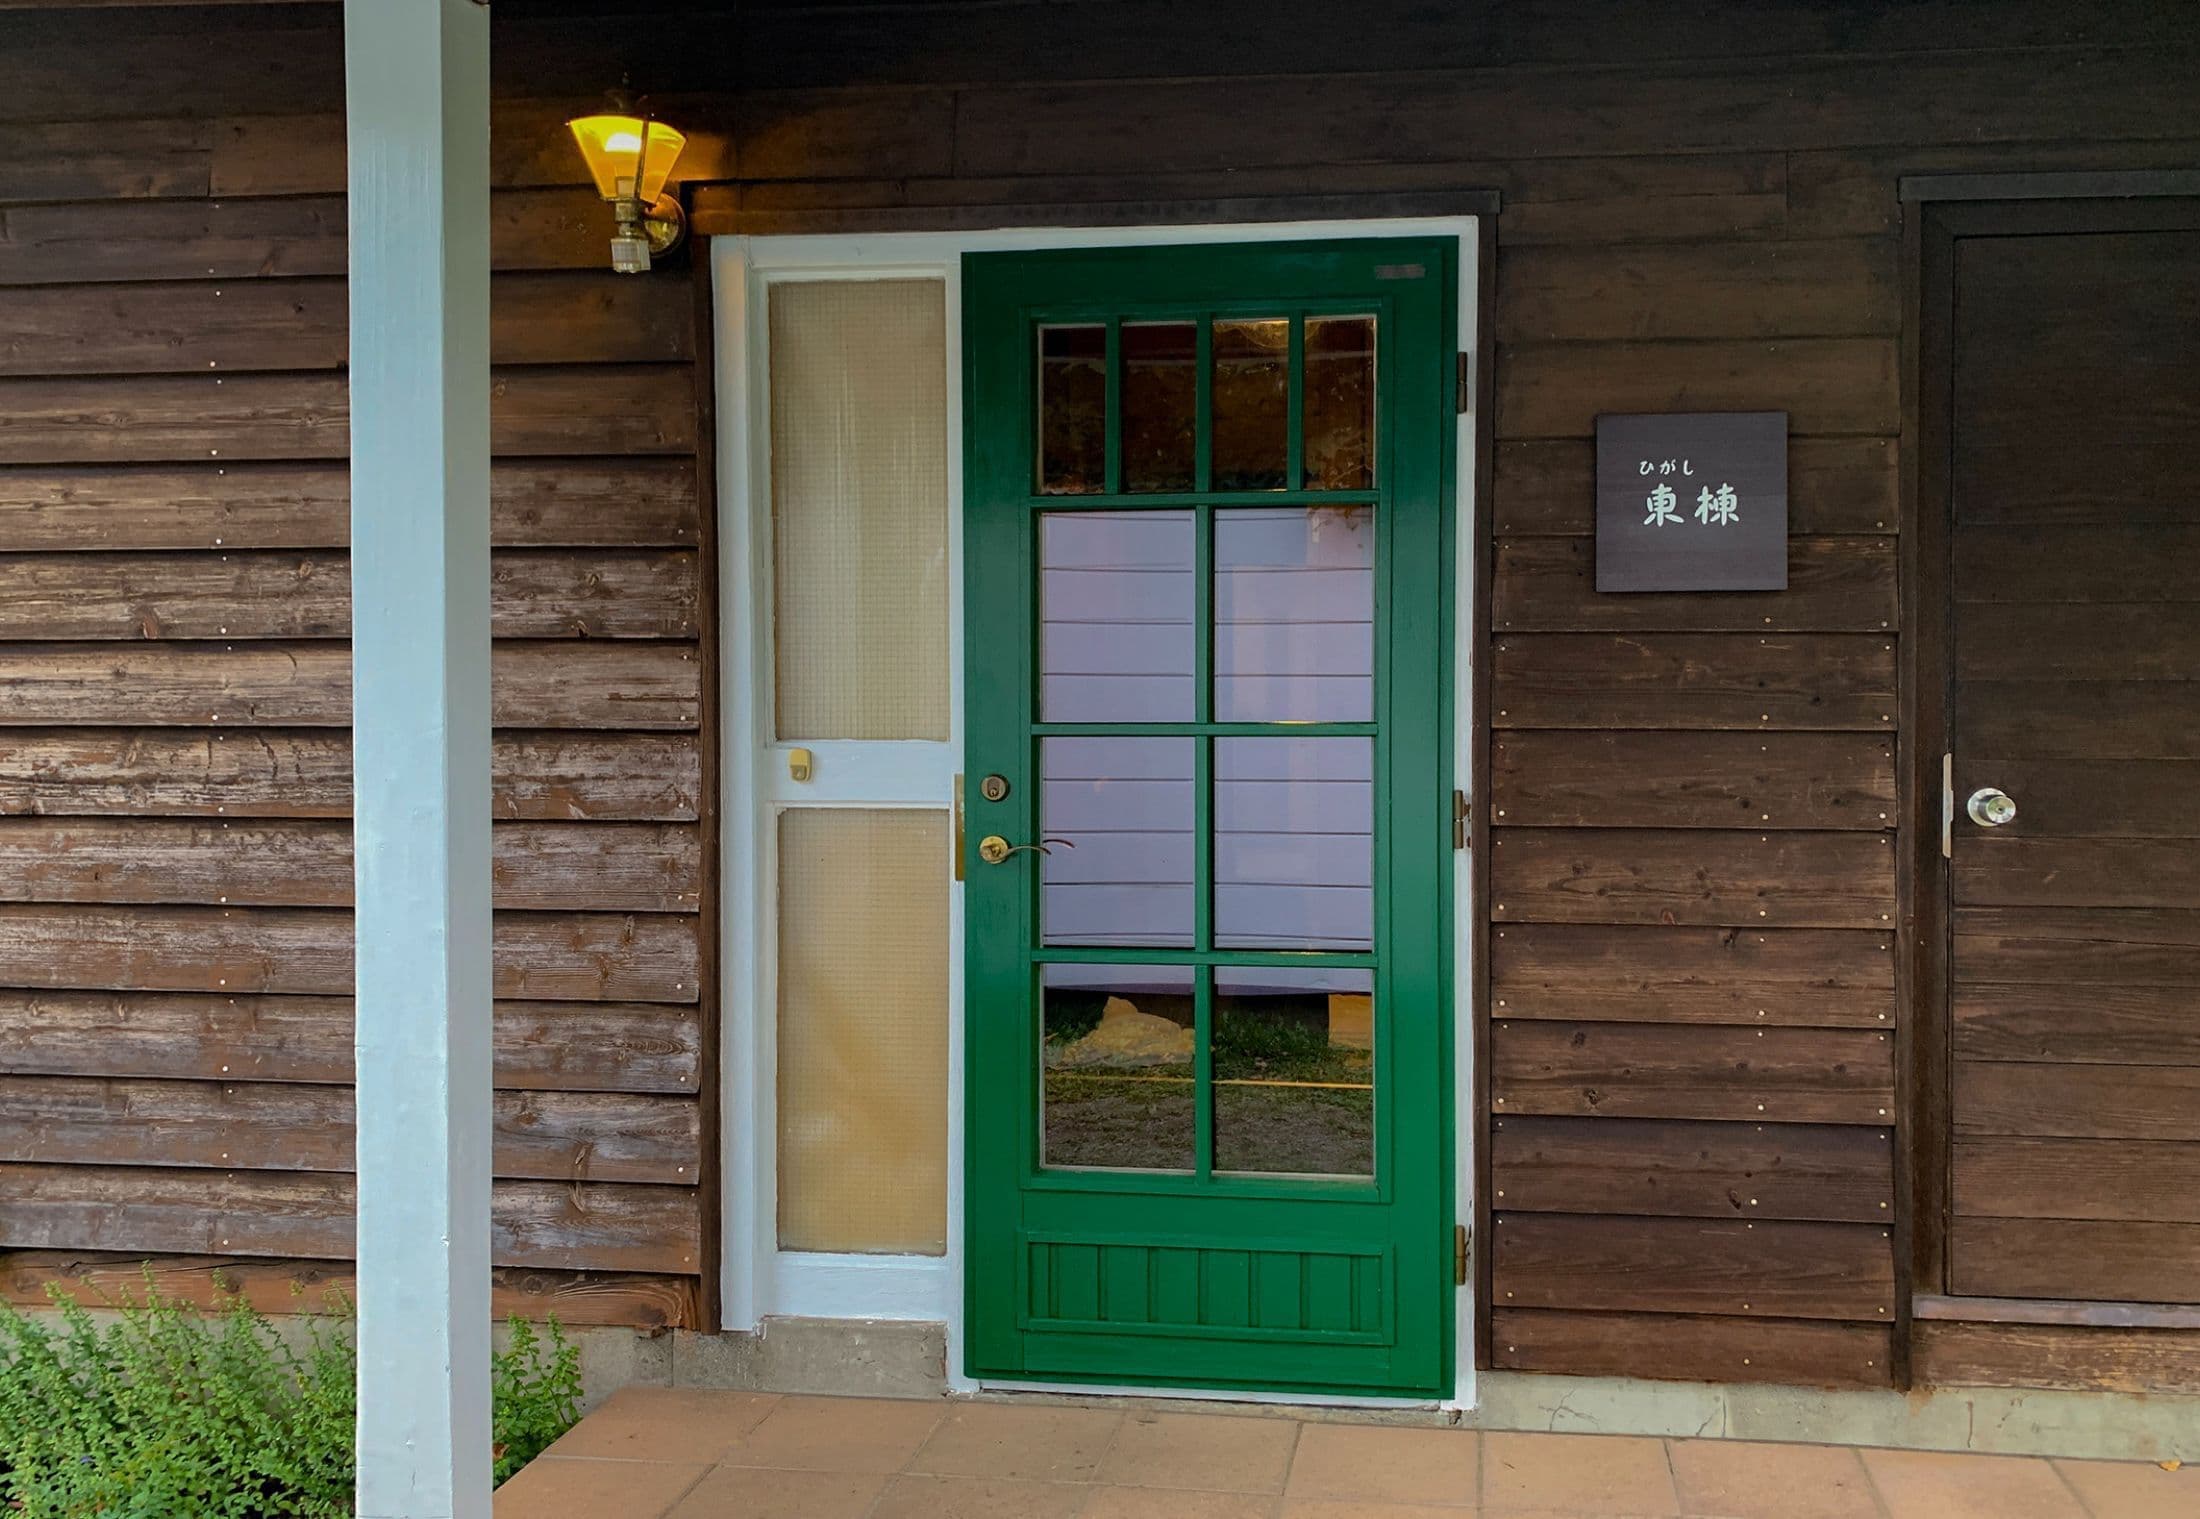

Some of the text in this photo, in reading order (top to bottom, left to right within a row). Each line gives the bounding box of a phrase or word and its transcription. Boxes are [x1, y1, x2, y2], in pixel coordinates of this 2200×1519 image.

[1639, 458, 1694, 476] ひがし
[1643, 482, 1740, 528] 東棟
